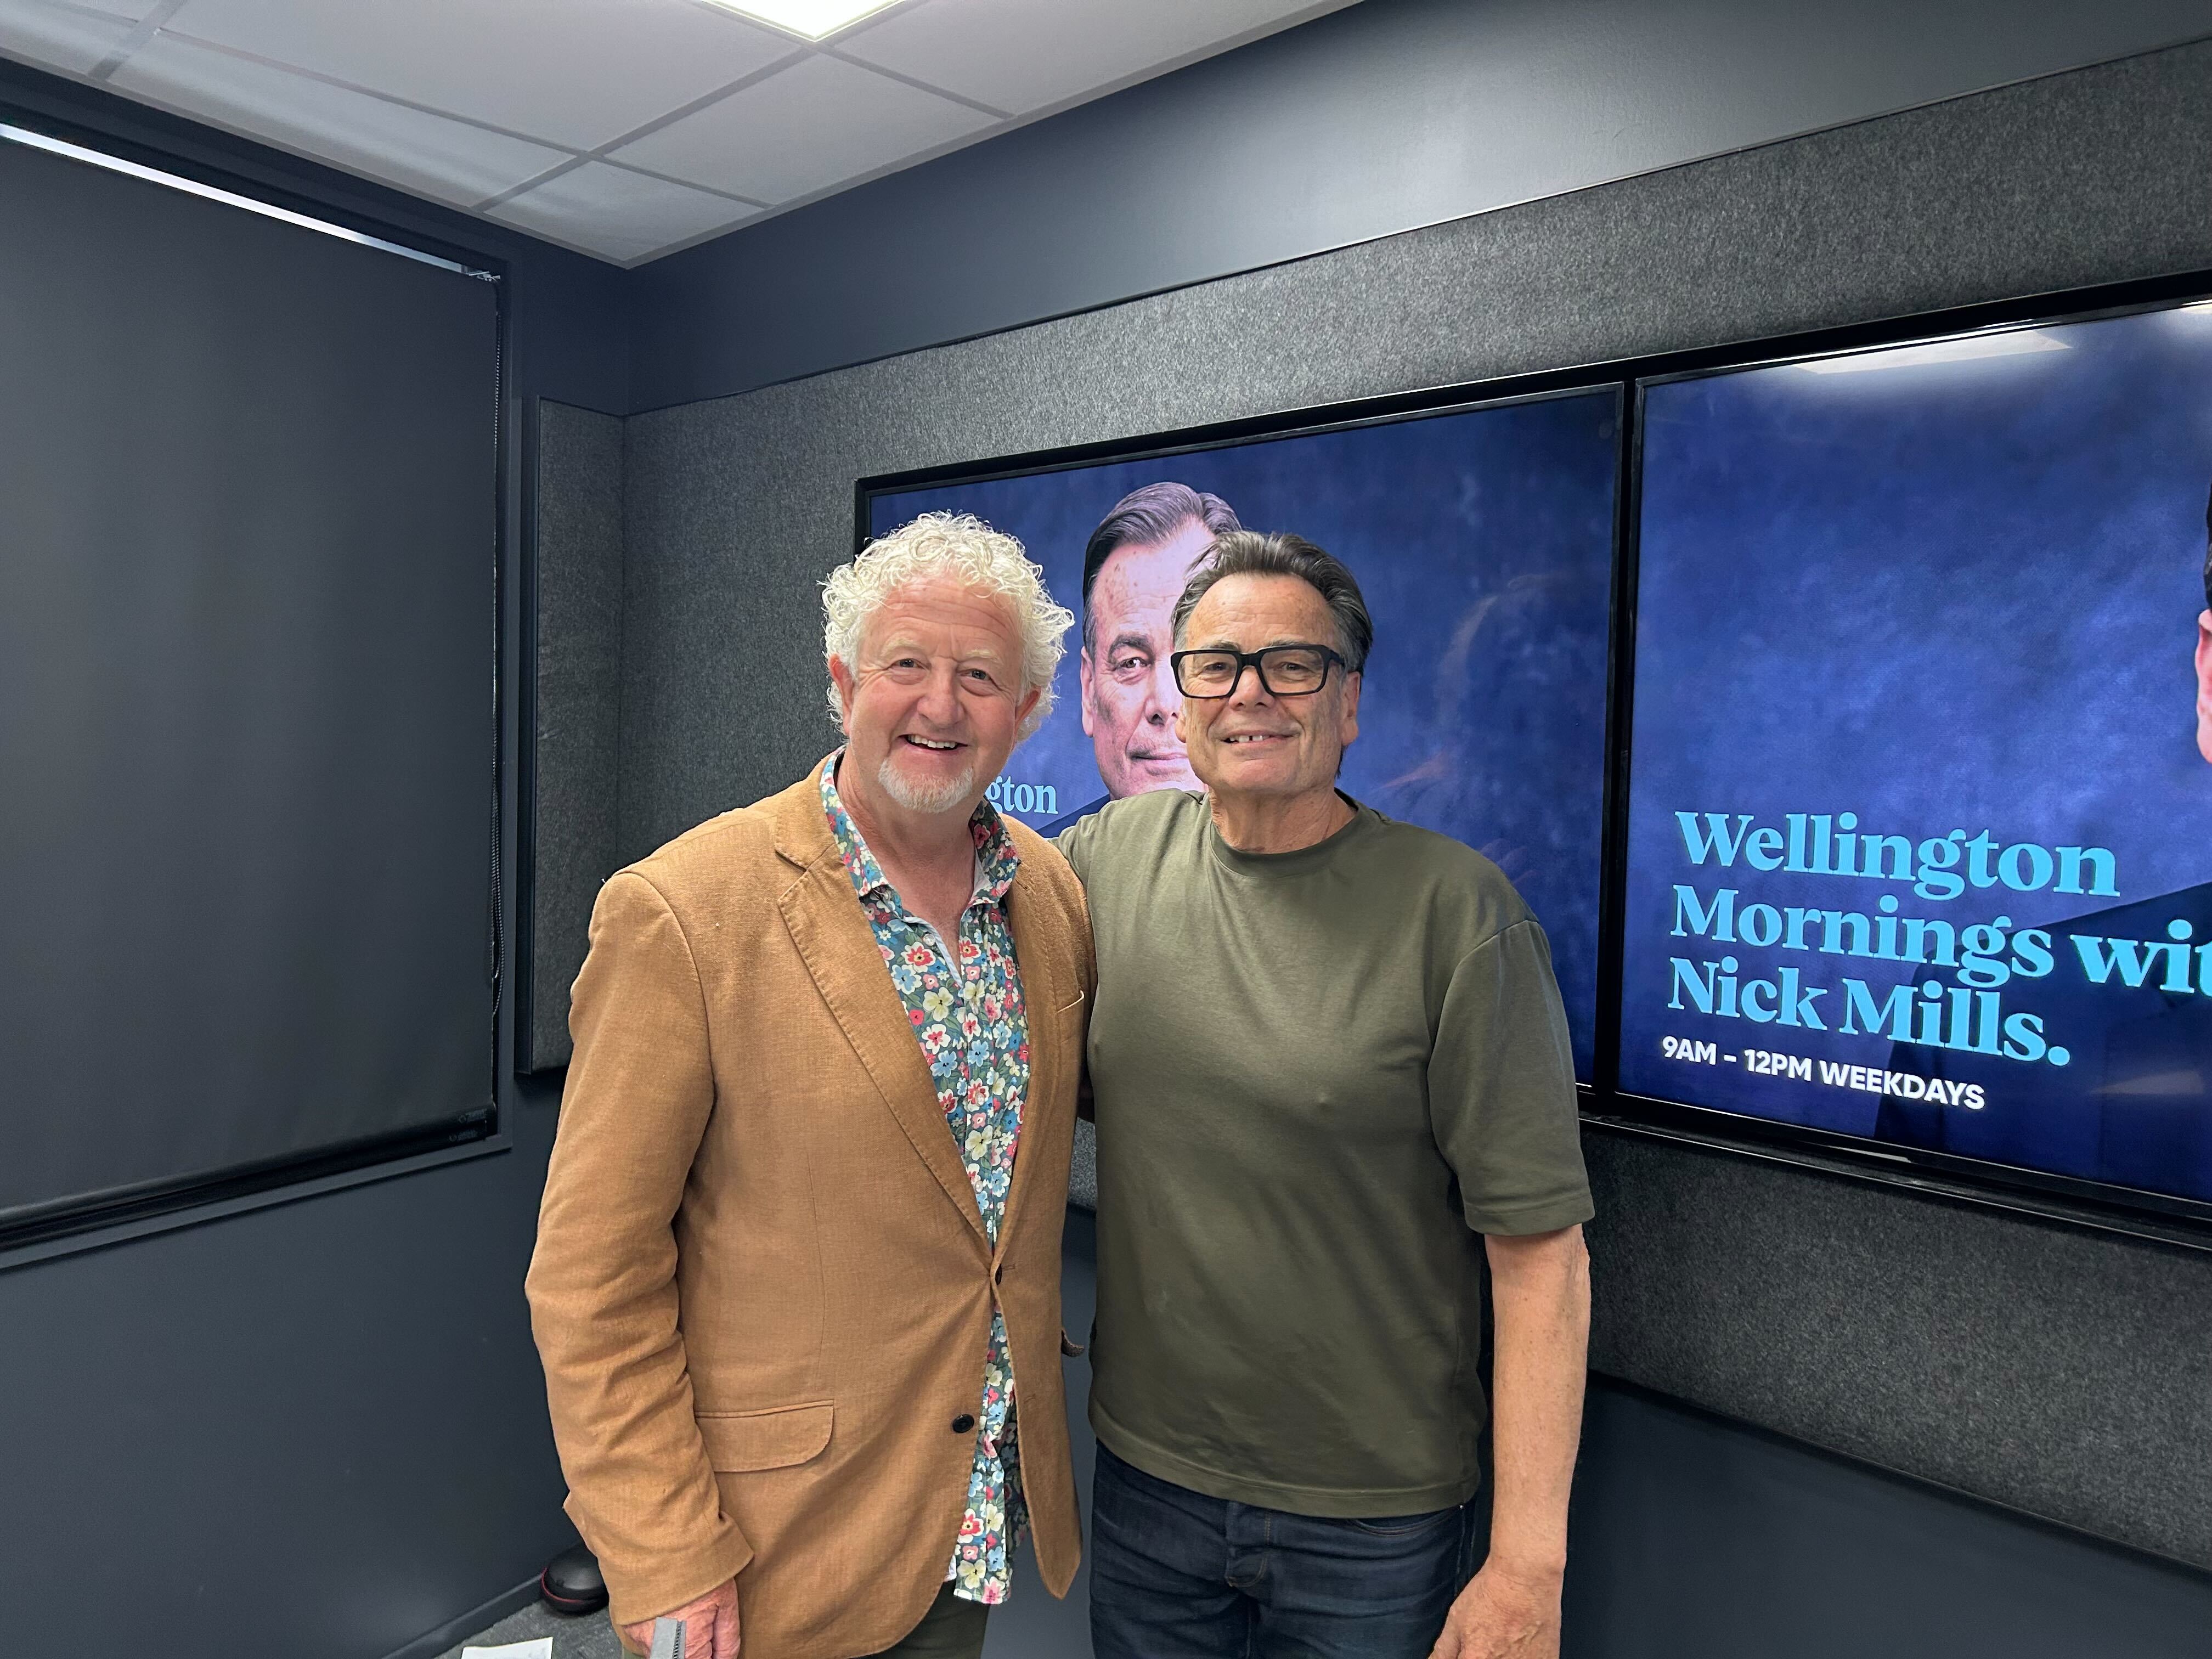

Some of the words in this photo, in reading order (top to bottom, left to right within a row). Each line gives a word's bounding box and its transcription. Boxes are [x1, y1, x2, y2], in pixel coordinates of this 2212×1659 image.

[1674, 811, 2121, 901] Wellington
[1670, 884, 2055, 988] Mornings
[1667, 956, 1829, 1031] Nick
[1838, 978, 2070, 1067] Mills.
[1662, 1035, 1717, 1065] 9AM
[1744, 1048, 1812, 1082] 12PM
[1819, 1059, 1985, 1110] WEEKDAYS
